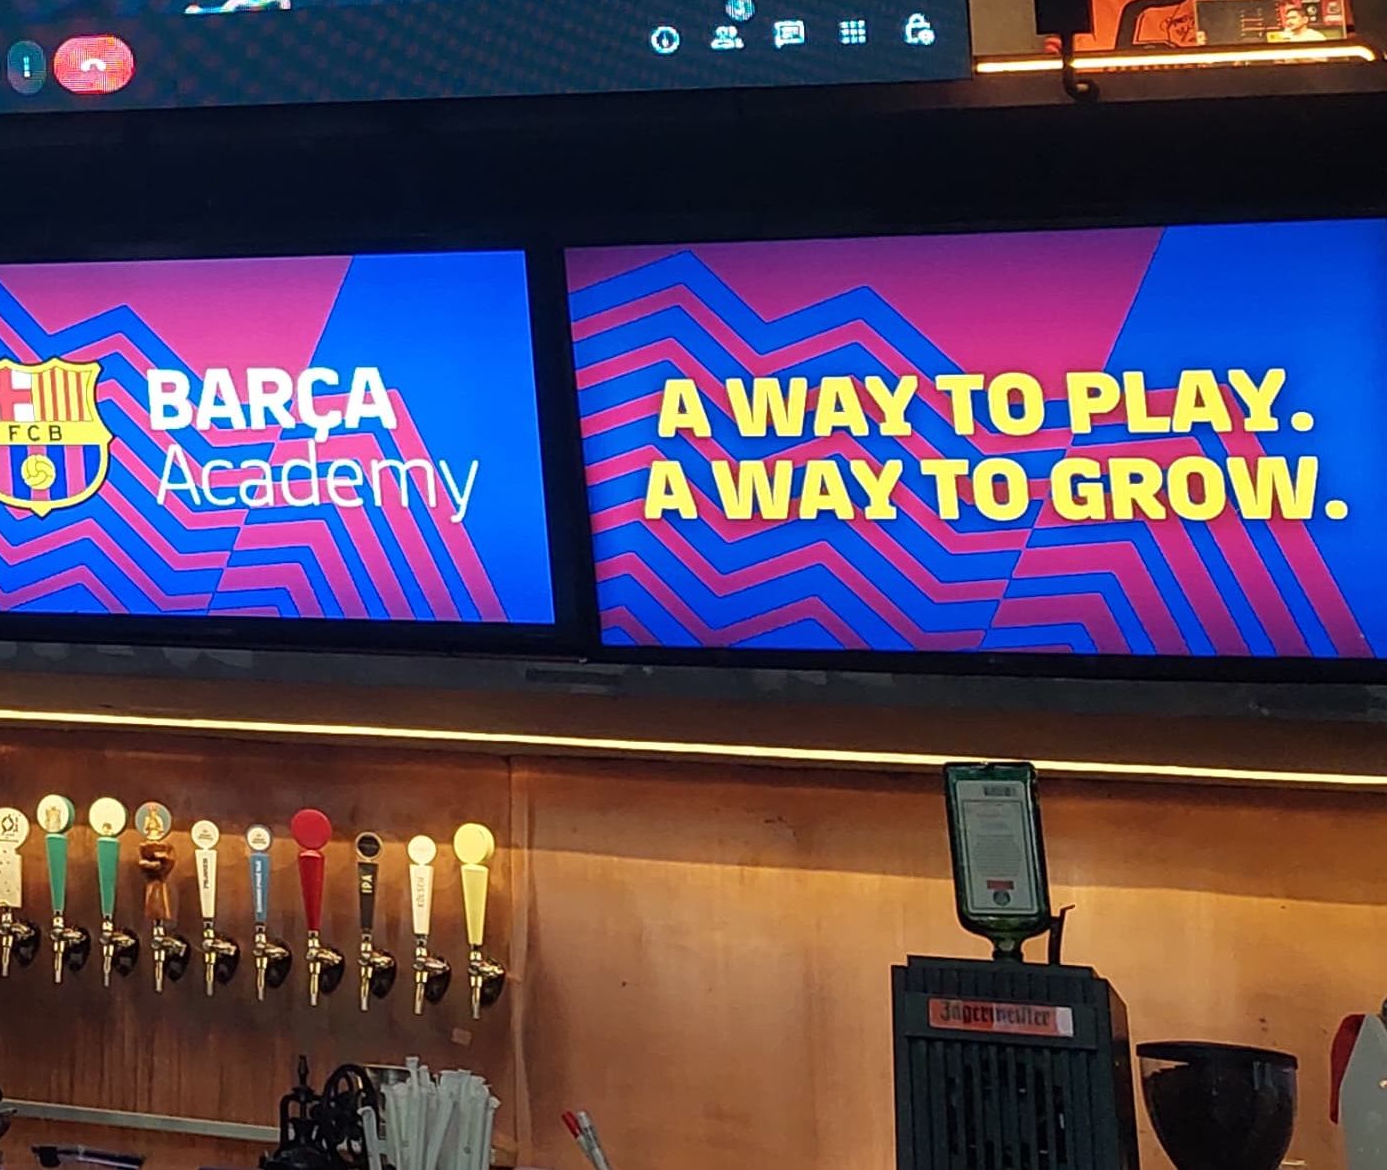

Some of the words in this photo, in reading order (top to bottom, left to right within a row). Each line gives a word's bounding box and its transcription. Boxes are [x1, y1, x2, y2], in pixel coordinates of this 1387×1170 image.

[146, 366, 399, 443] BARÇA
[657, 378, 713, 438] A
[725, 375, 920, 437] WAY
[935, 372, 1046, 436] TO
[1066, 368, 1315, 435] PLAY.
[156, 439, 480, 524] Academy
[643, 459, 699, 520] A
[711, 458, 906, 521] WAY
[920, 457, 1031, 521] TO
[1051, 455, 1350, 522] GROW.
[361, 874, 373, 894] IPA
